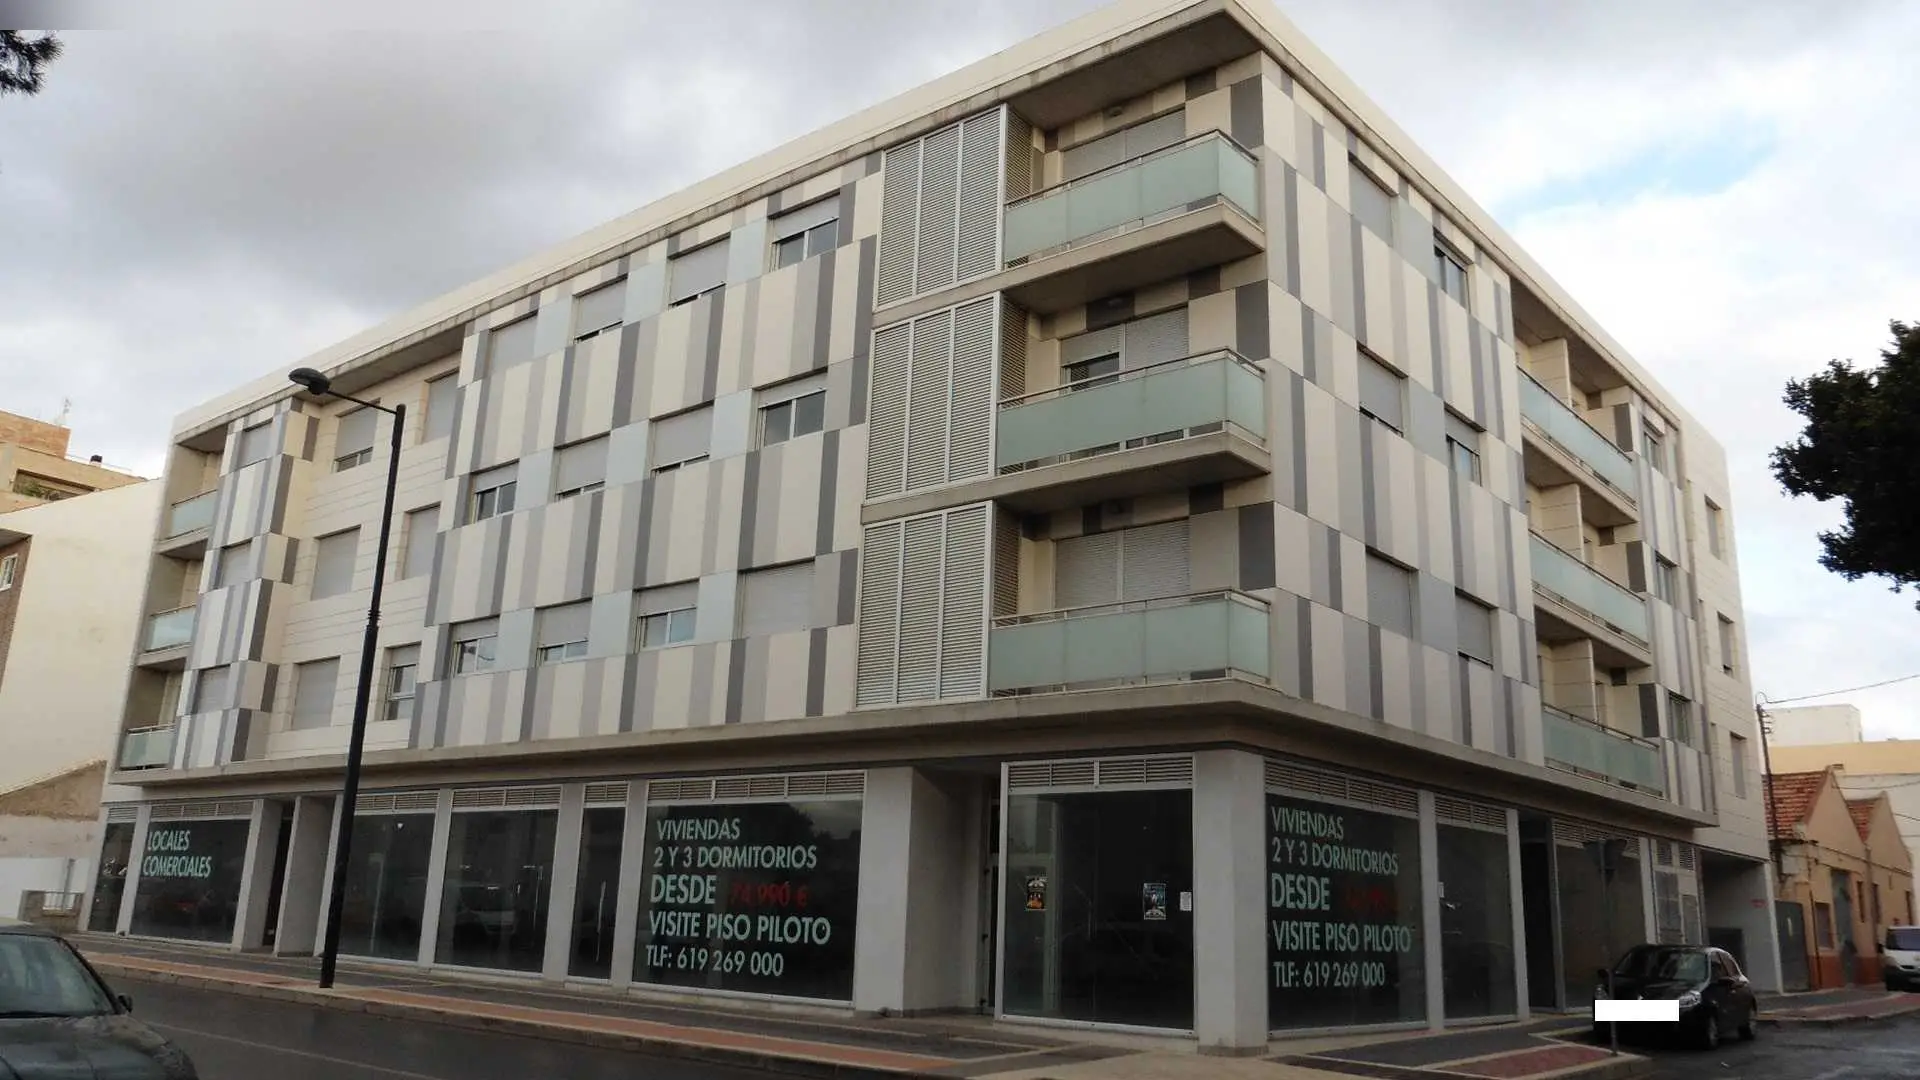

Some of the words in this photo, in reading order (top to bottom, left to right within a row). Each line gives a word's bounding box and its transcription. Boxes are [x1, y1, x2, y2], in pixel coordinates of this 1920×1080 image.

[657, 817, 741, 840] VIVIENDAS
[1271, 806, 1344, 840] VIVIENDAS
[147, 830, 190, 851] LOCALES
[1272, 836, 1281, 862] 2
[1286, 838, 1296, 864] Y
[1299, 840, 1308, 867] 3
[1312, 843, 1399, 876] DORMITORIOS
[143, 856, 212, 878] COMERCIALES
[653, 846, 664, 868] 2
[668, 846, 679, 868] Y
[683, 846, 693, 868] 3
[698, 845, 817, 869] DORMITORIOS
[650, 874, 717, 904] DESDE
[1271, 872, 1331, 911] DESDE
[649, 910, 700, 938] VISITE
[706, 913, 751, 941] PISO
[757, 915, 831, 945] PILOTO
[1272, 919, 1321, 951] VISITE
[1325, 922, 1359, 952] PISO
[1364, 924, 1412, 952] PILOTO
[645, 944, 672, 968] TLF:
[677, 947, 708, 970] 619
[712, 950, 746, 974] 269
[750, 952, 784, 977] 000
[1273, 961, 1300, 988] TLF:
[1304, 961, 1330, 988] 619
[1332, 962, 1359, 988] 269
[1362, 962, 1385, 986] 000
